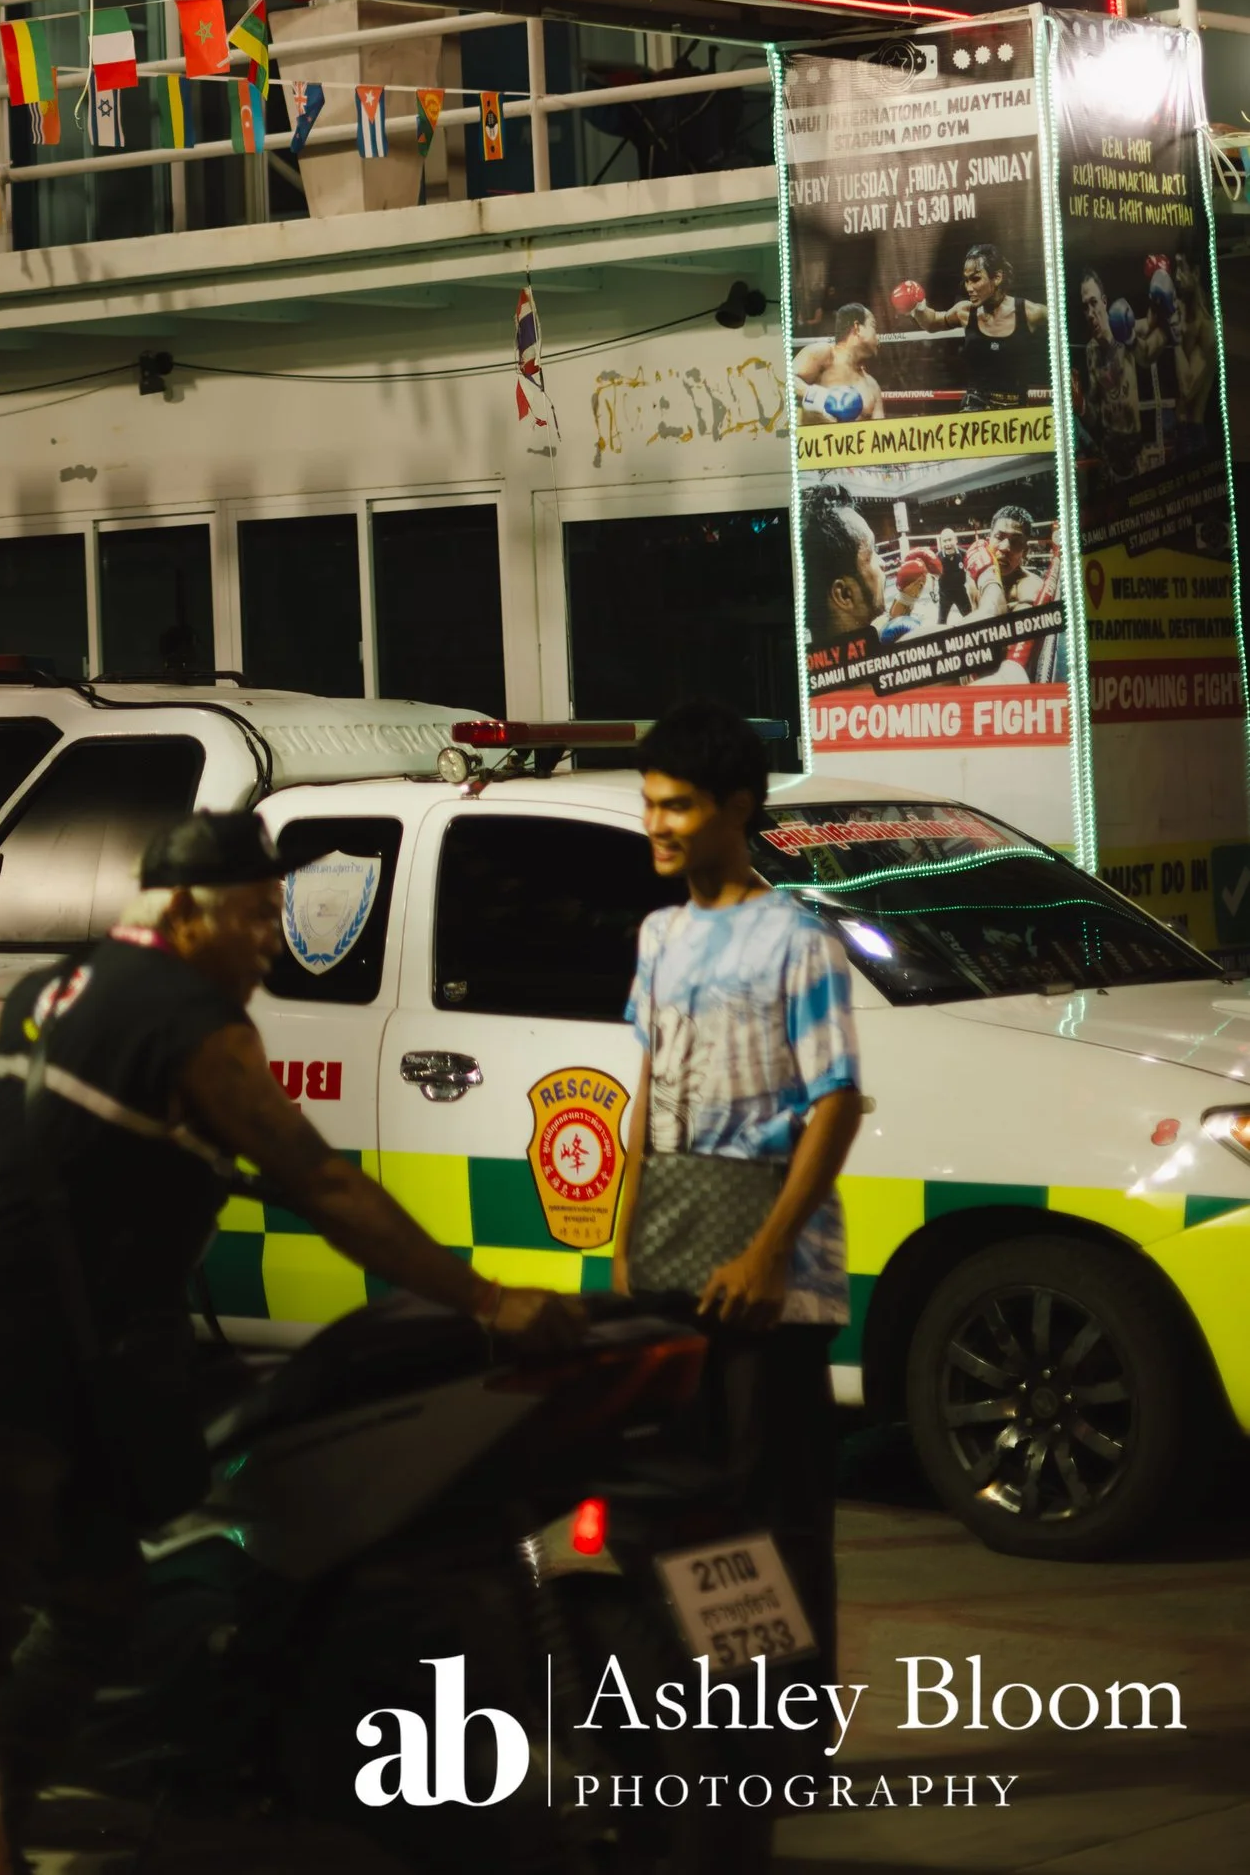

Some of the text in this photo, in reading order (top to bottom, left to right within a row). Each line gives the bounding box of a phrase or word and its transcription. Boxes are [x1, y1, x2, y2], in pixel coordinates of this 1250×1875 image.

[787, 88, 1031, 135] AMUI INTERNATIONAL MUAYTHAI
[833, 118, 970, 152] STADIUM AND GYM
[1101, 135, 1126, 160] REAL
[788, 176, 830, 207] EVERY
[835, 167, 900, 203] TUESDAY
[1073, 162, 1095, 189] RICH
[1161, 172, 1187, 196] ARTS
[843, 192, 976, 234] START AT 9.30 PM
[1069, 193, 1090, 217] LIVE
[1093, 195, 1117, 220] REAL
[797, 429, 867, 460] CULTURE
[1111, 576, 1188, 600] WELCOME TO
[1168, 617, 1236, 639] DESTINATIO
[810, 609, 1063, 690] SAMUI INTERNATIONAL MUAYTHAI BOXING
[846, 638, 867, 660] AT
[878, 647, 993, 690] STADIUM AND GYM
[1091, 671, 1244, 711] UPCOMING FIGHT
[809, 698, 1069, 741] UPCOMING FIGHT
[1161, 859, 1186, 895] DO
[1190, 857, 1208, 892] IN
[539, 1077, 619, 1112] RESCUE
[711, 1618, 797, 1666] 5733
